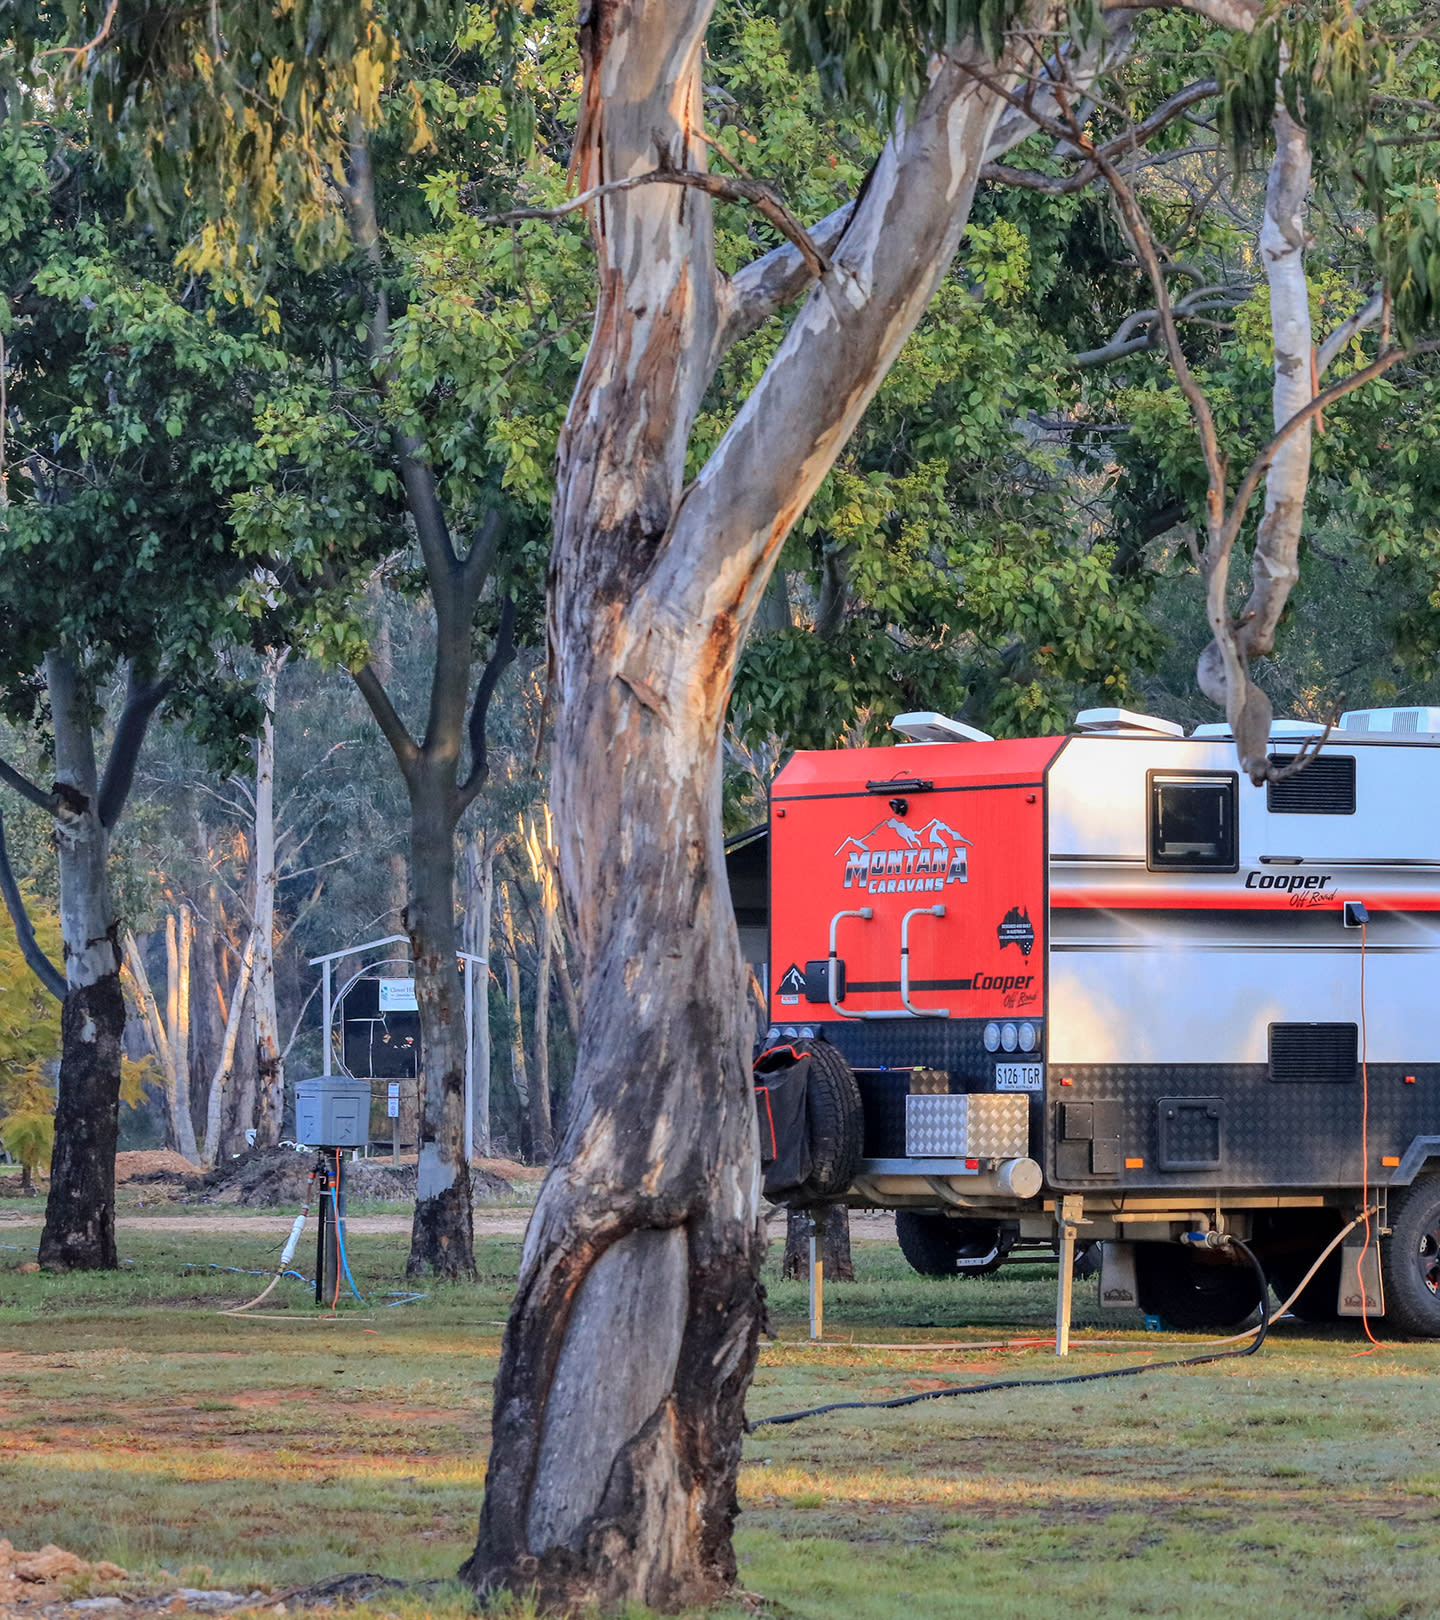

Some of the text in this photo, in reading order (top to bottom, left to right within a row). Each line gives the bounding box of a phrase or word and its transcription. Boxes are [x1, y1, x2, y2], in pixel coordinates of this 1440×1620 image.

[843, 847, 969, 888] MONTANA
[868, 877, 945, 894] CARAVANS
[1245, 871, 1332, 893] Cooper
[972, 972, 1035, 994] Cooper
